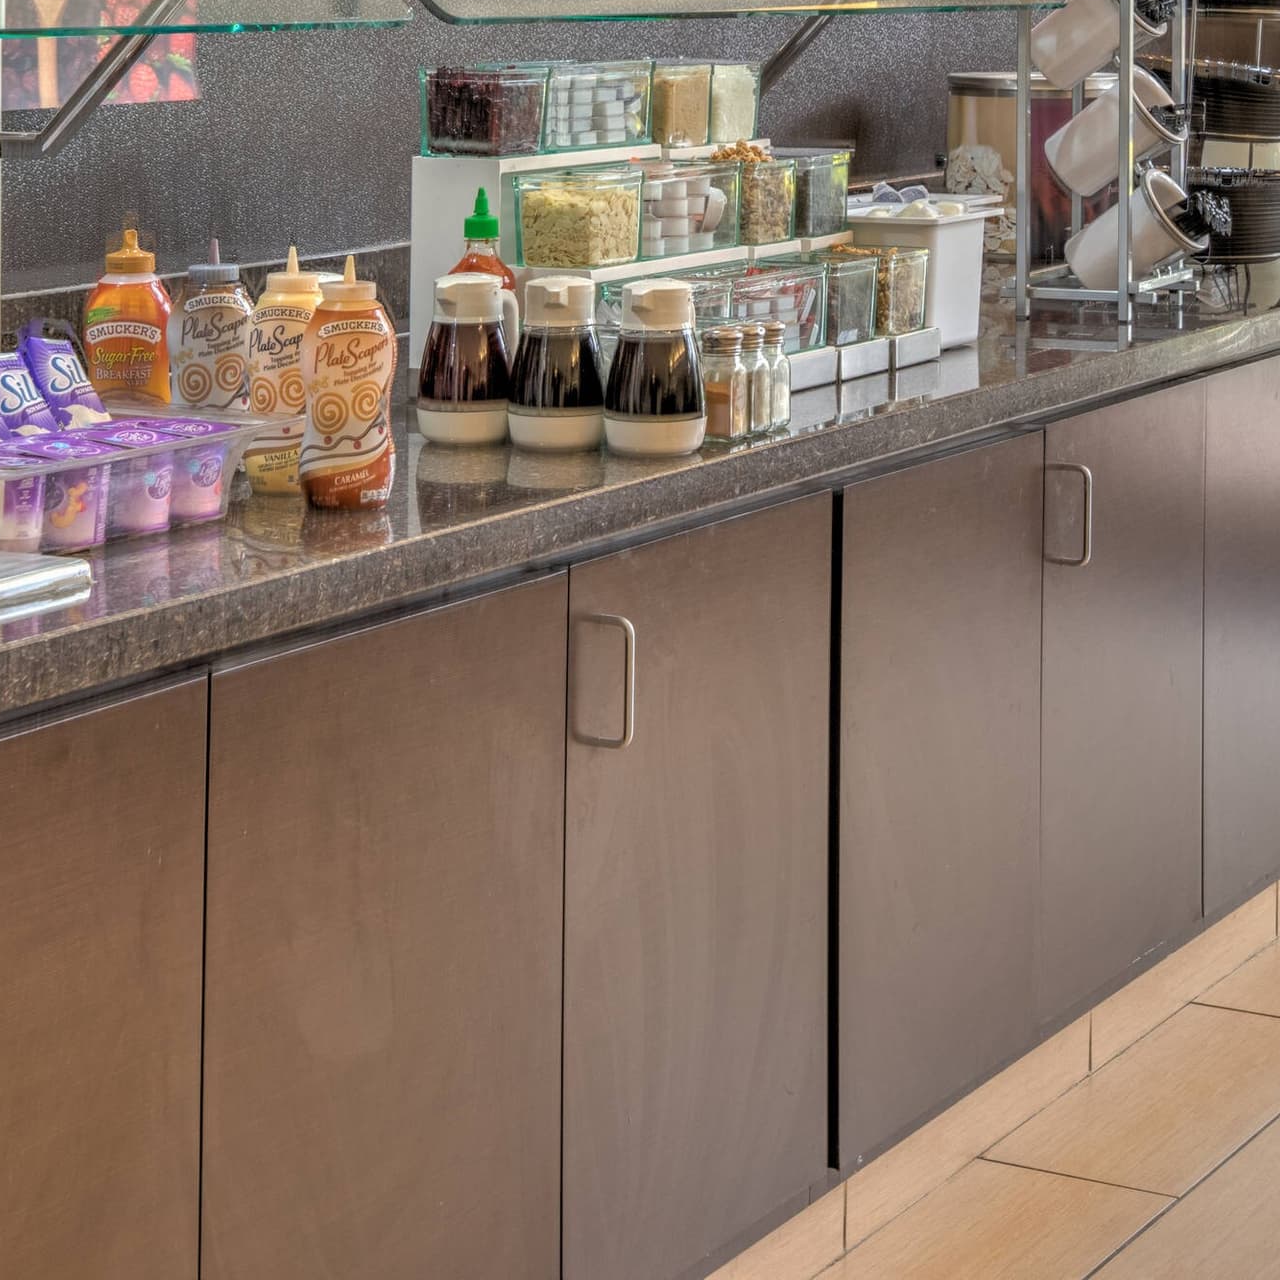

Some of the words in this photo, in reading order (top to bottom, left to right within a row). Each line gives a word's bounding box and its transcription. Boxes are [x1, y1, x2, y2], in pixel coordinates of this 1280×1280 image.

[255, 308, 312, 321] SMUCKER'S
[89, 323, 158, 340] SMUCKER'S
[323, 320, 384, 335] SMUCKER'S
[334, 470, 370, 485] CARAMEL
